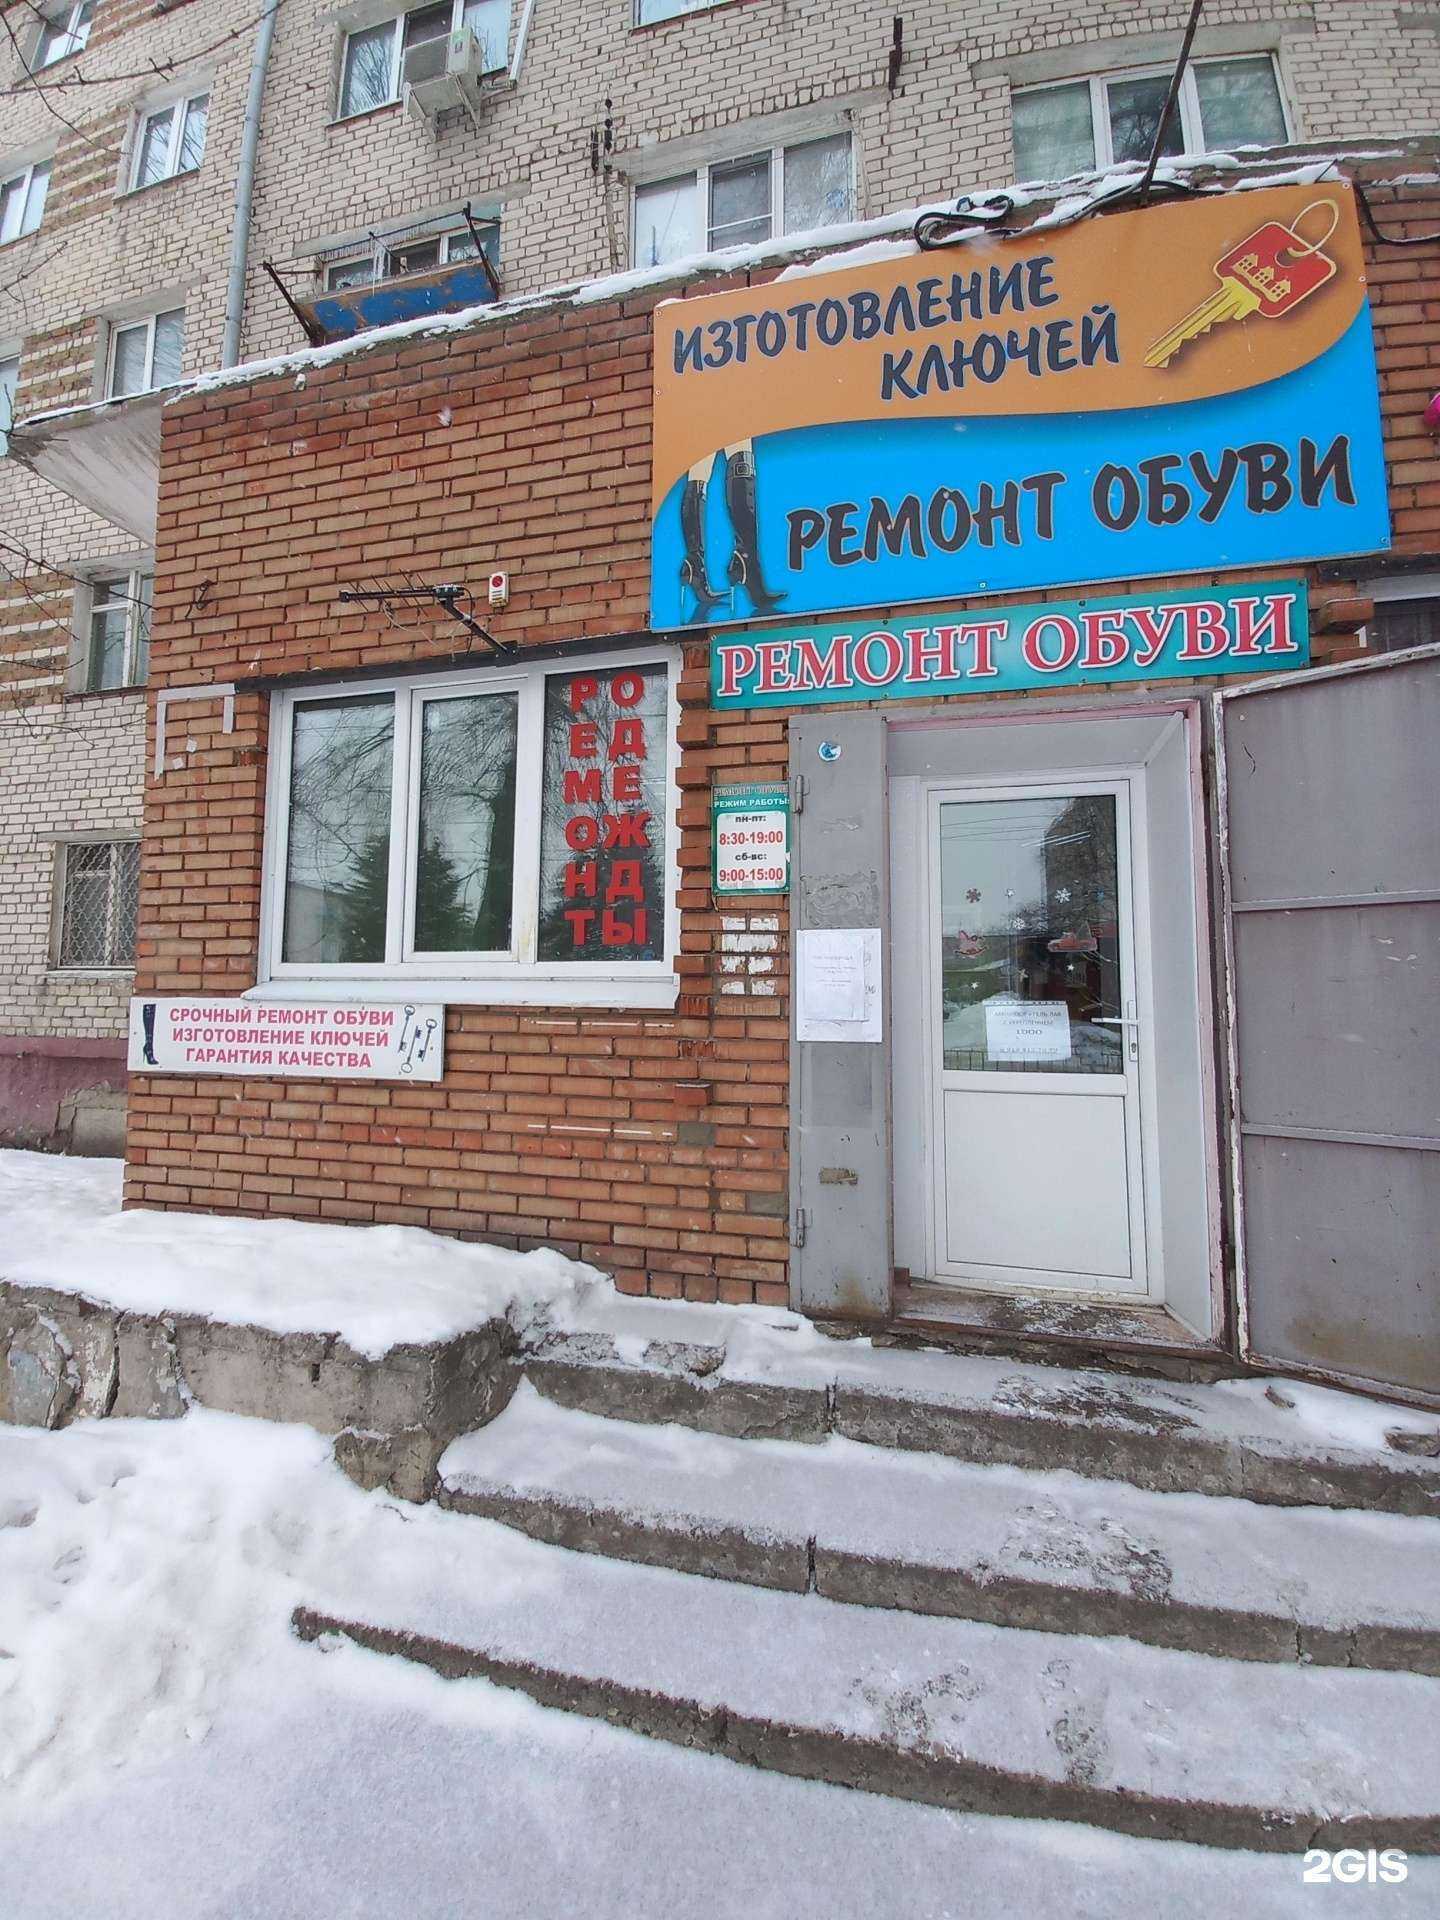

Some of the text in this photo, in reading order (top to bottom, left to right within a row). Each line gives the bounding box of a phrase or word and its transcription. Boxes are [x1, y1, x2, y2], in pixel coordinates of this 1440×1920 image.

[672, 255, 1060, 376] ИЗГОТОВЛЕНИЕ
[880, 304, 1120, 401] КЛЮЧЕЙ
[785, 434, 1357, 573] РЕМОНТ ОБУВИ
[715, 592, 1299, 699] РЕМОНТ ОБУВИ
[563, 675, 603, 946] РЕМОНТ
[602, 672, 651, 946] ОДЕЖДЫ
[714, 800, 747, 808] РЕЖИМ
[719, 830, 784, 846] 8:30-19:00
[719, 867, 784, 882] 9:00-15:00
[169, 1007, 394, 1026] СРОЧНЫЙ РЕМОНТ ОБУВИ
[172, 1028, 389, 1047] ИЗГОТОВЛЕНИЕ КЛЮЧЕЙ
[185, 1048, 372, 1068] ГАРАНТИЯ КАЧЕСТВА
